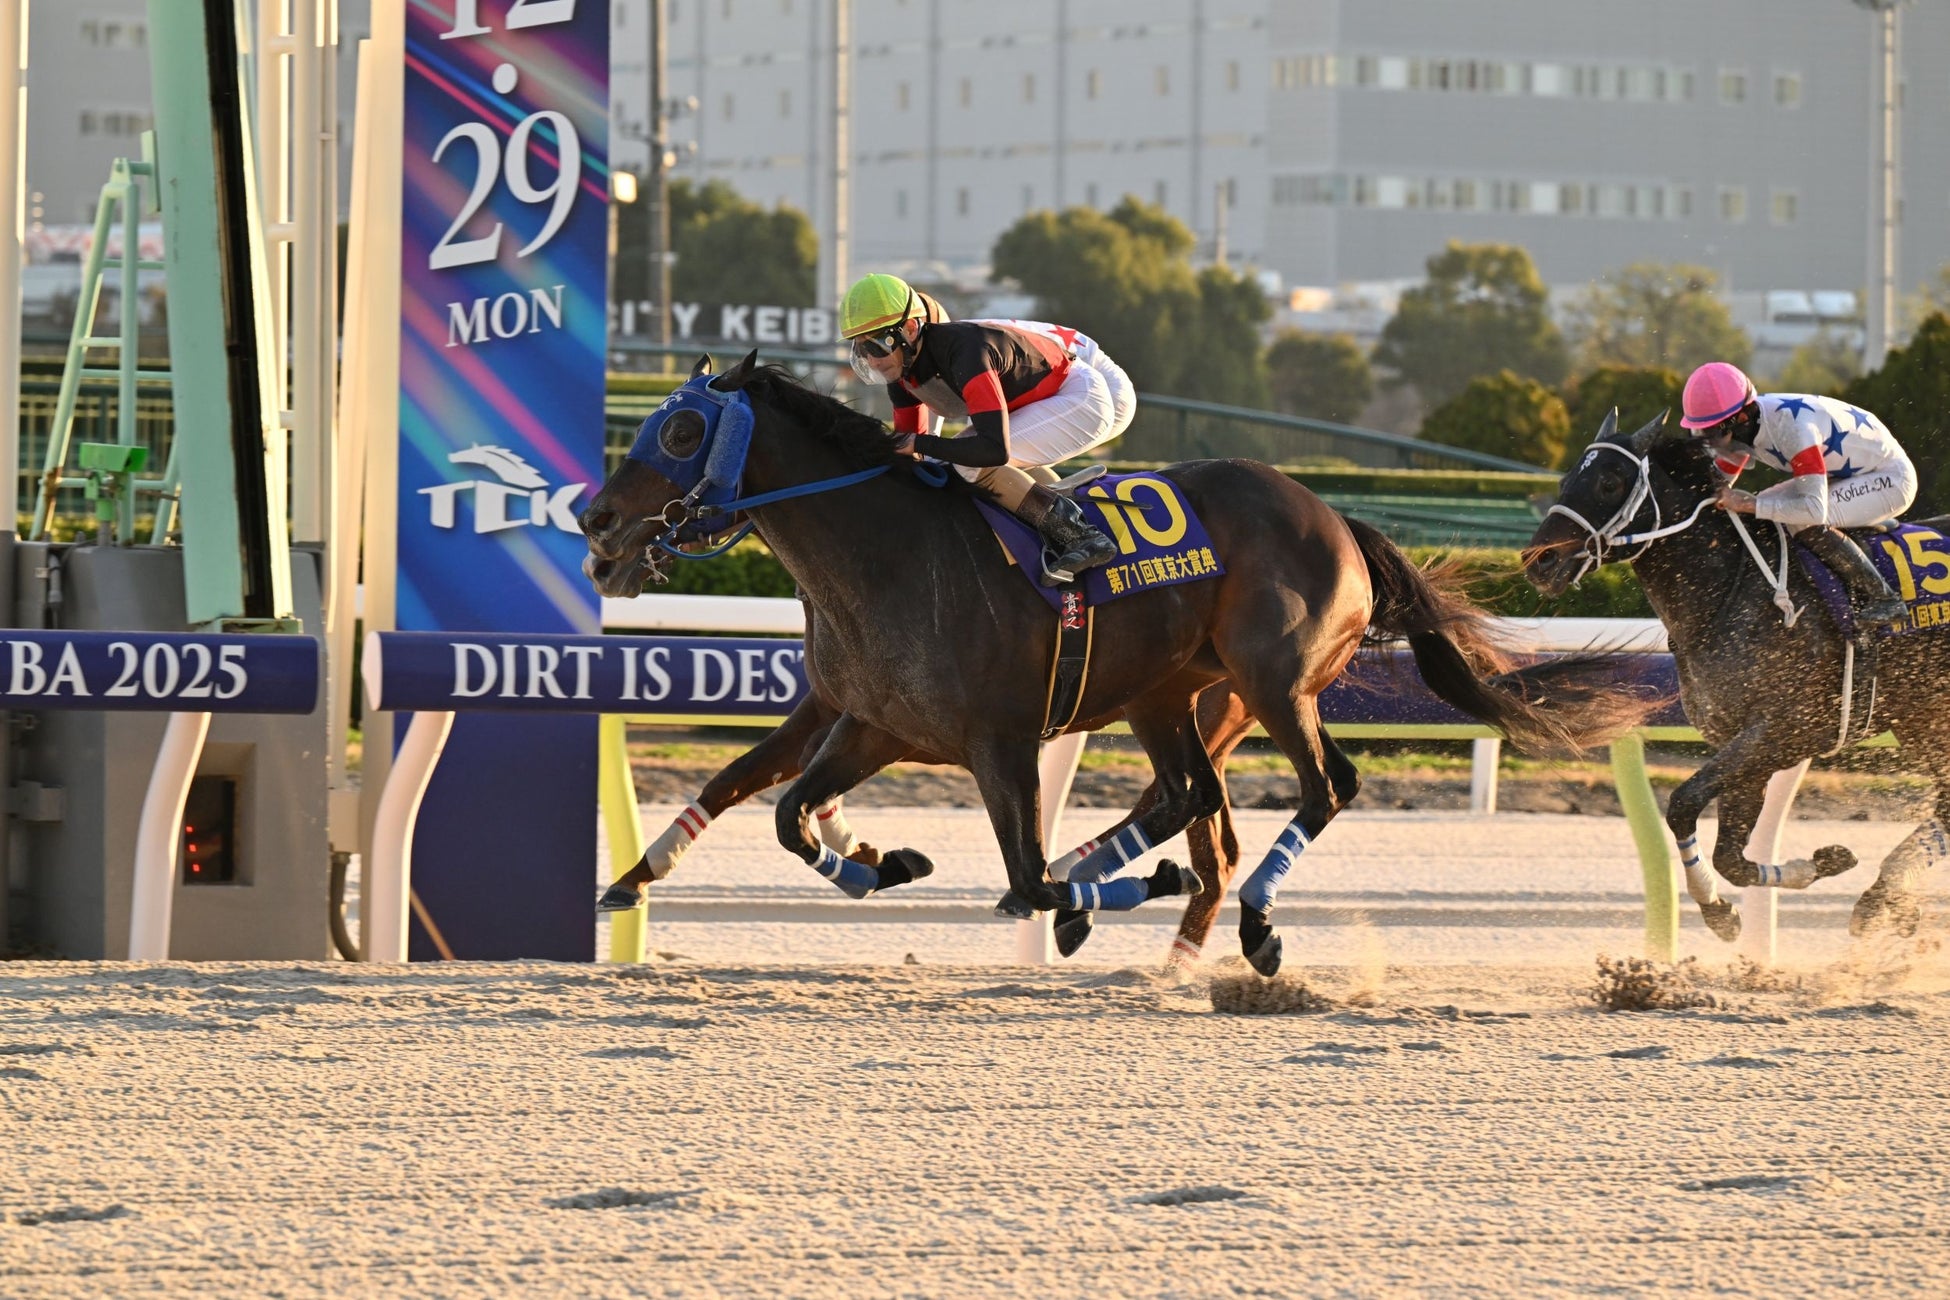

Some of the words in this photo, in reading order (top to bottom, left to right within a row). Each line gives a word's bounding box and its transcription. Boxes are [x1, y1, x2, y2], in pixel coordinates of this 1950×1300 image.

[428, 110, 581, 271] 29
[445, 285, 565, 348] MON
[720, 302, 842, 344] KEIB
[1088, 478, 1187, 555] 10
[1106, 546, 1218, 595] 第71回東京大賞典
[1881, 531, 1950, 601] 15
[0, 640, 92, 696] BA
[104, 642, 248, 699] 2025
[450, 643, 603, 699] DIRT
[619, 647, 671, 701] IS
[688, 648, 805, 702] DES
